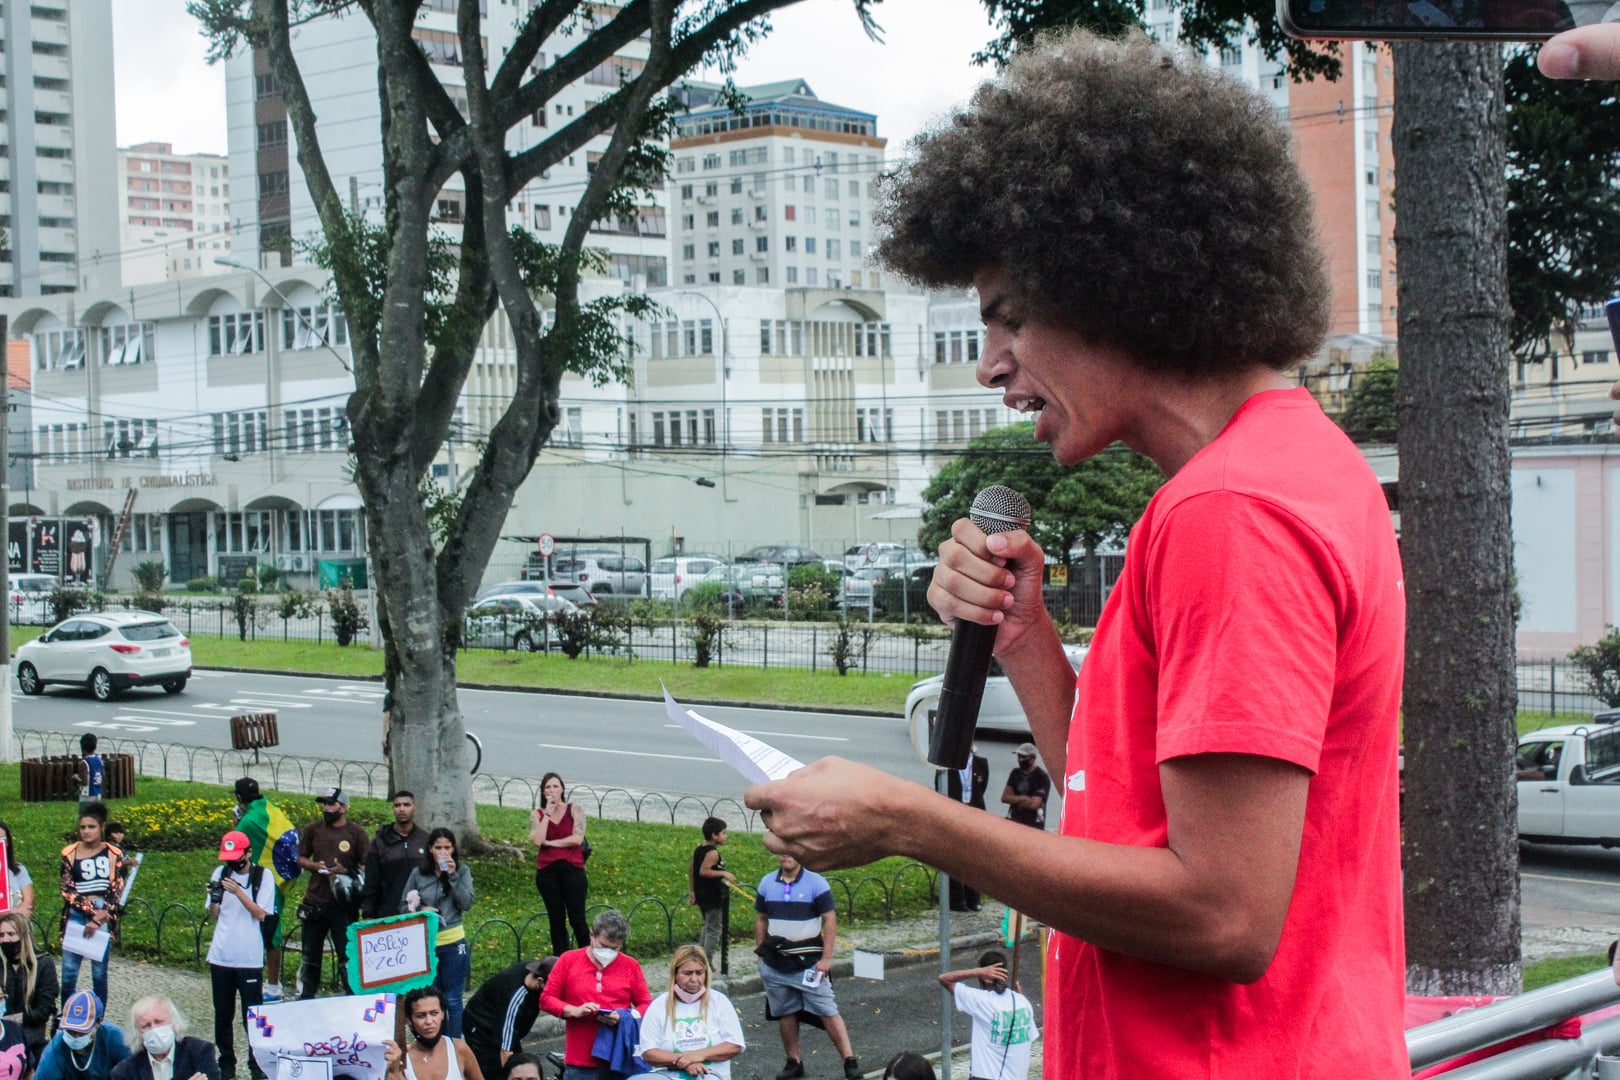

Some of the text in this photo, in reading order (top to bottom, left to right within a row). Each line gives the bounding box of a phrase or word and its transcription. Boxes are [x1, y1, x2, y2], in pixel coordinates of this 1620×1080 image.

[541, 537, 553, 550] 50
[1051, 565, 1066, 578] 24
[80, 855, 110, 880] 99
